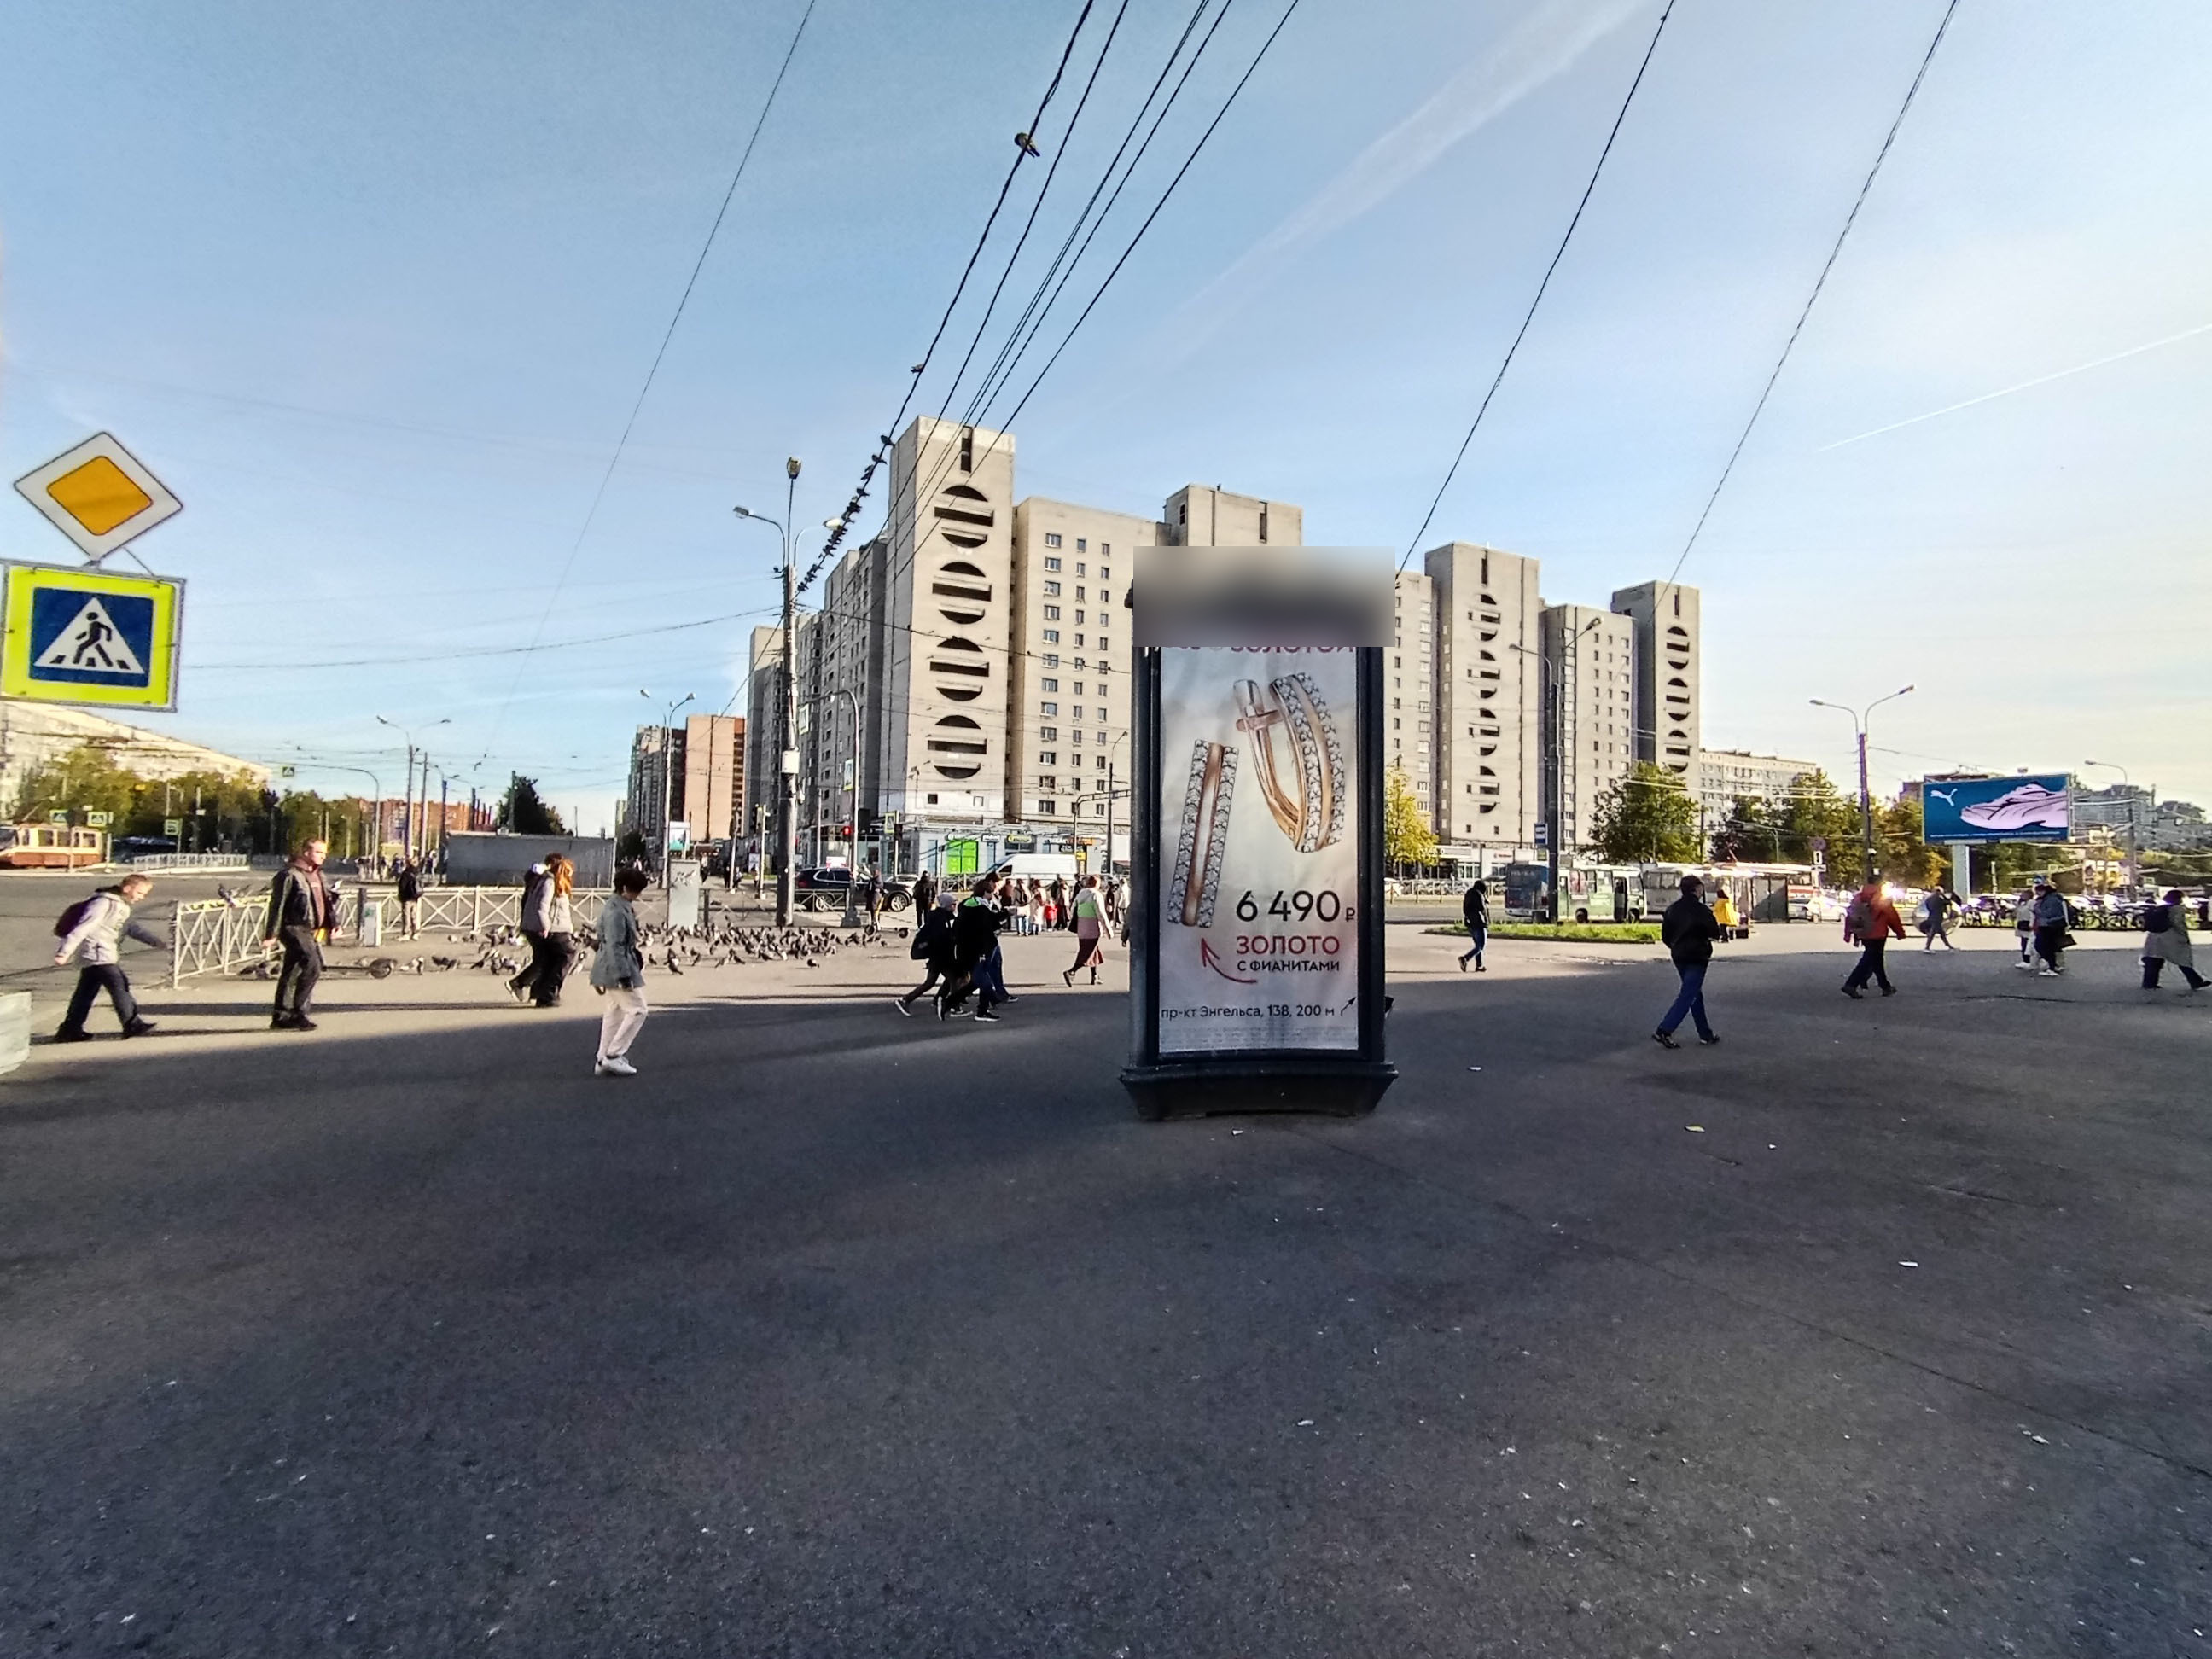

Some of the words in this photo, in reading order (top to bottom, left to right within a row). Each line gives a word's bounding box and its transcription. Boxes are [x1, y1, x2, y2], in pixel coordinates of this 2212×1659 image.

[1236, 890, 1259, 923] 6
[1267, 890, 1341, 923] 490
[1236, 935, 1340, 955] ЗОЛОТО
[1237, 960, 1247, 972] С
[1249, 959, 1340, 972] ФИАНИТАМИ
[1161, 1008, 1197, 1021] пр-кт
[1200, 1005, 1264, 1019] Энгельса,
[1267, 1004, 1292, 1018] 138,
[1296, 1004, 1322, 1016] 200
[1325, 1008, 1335, 1016] м
